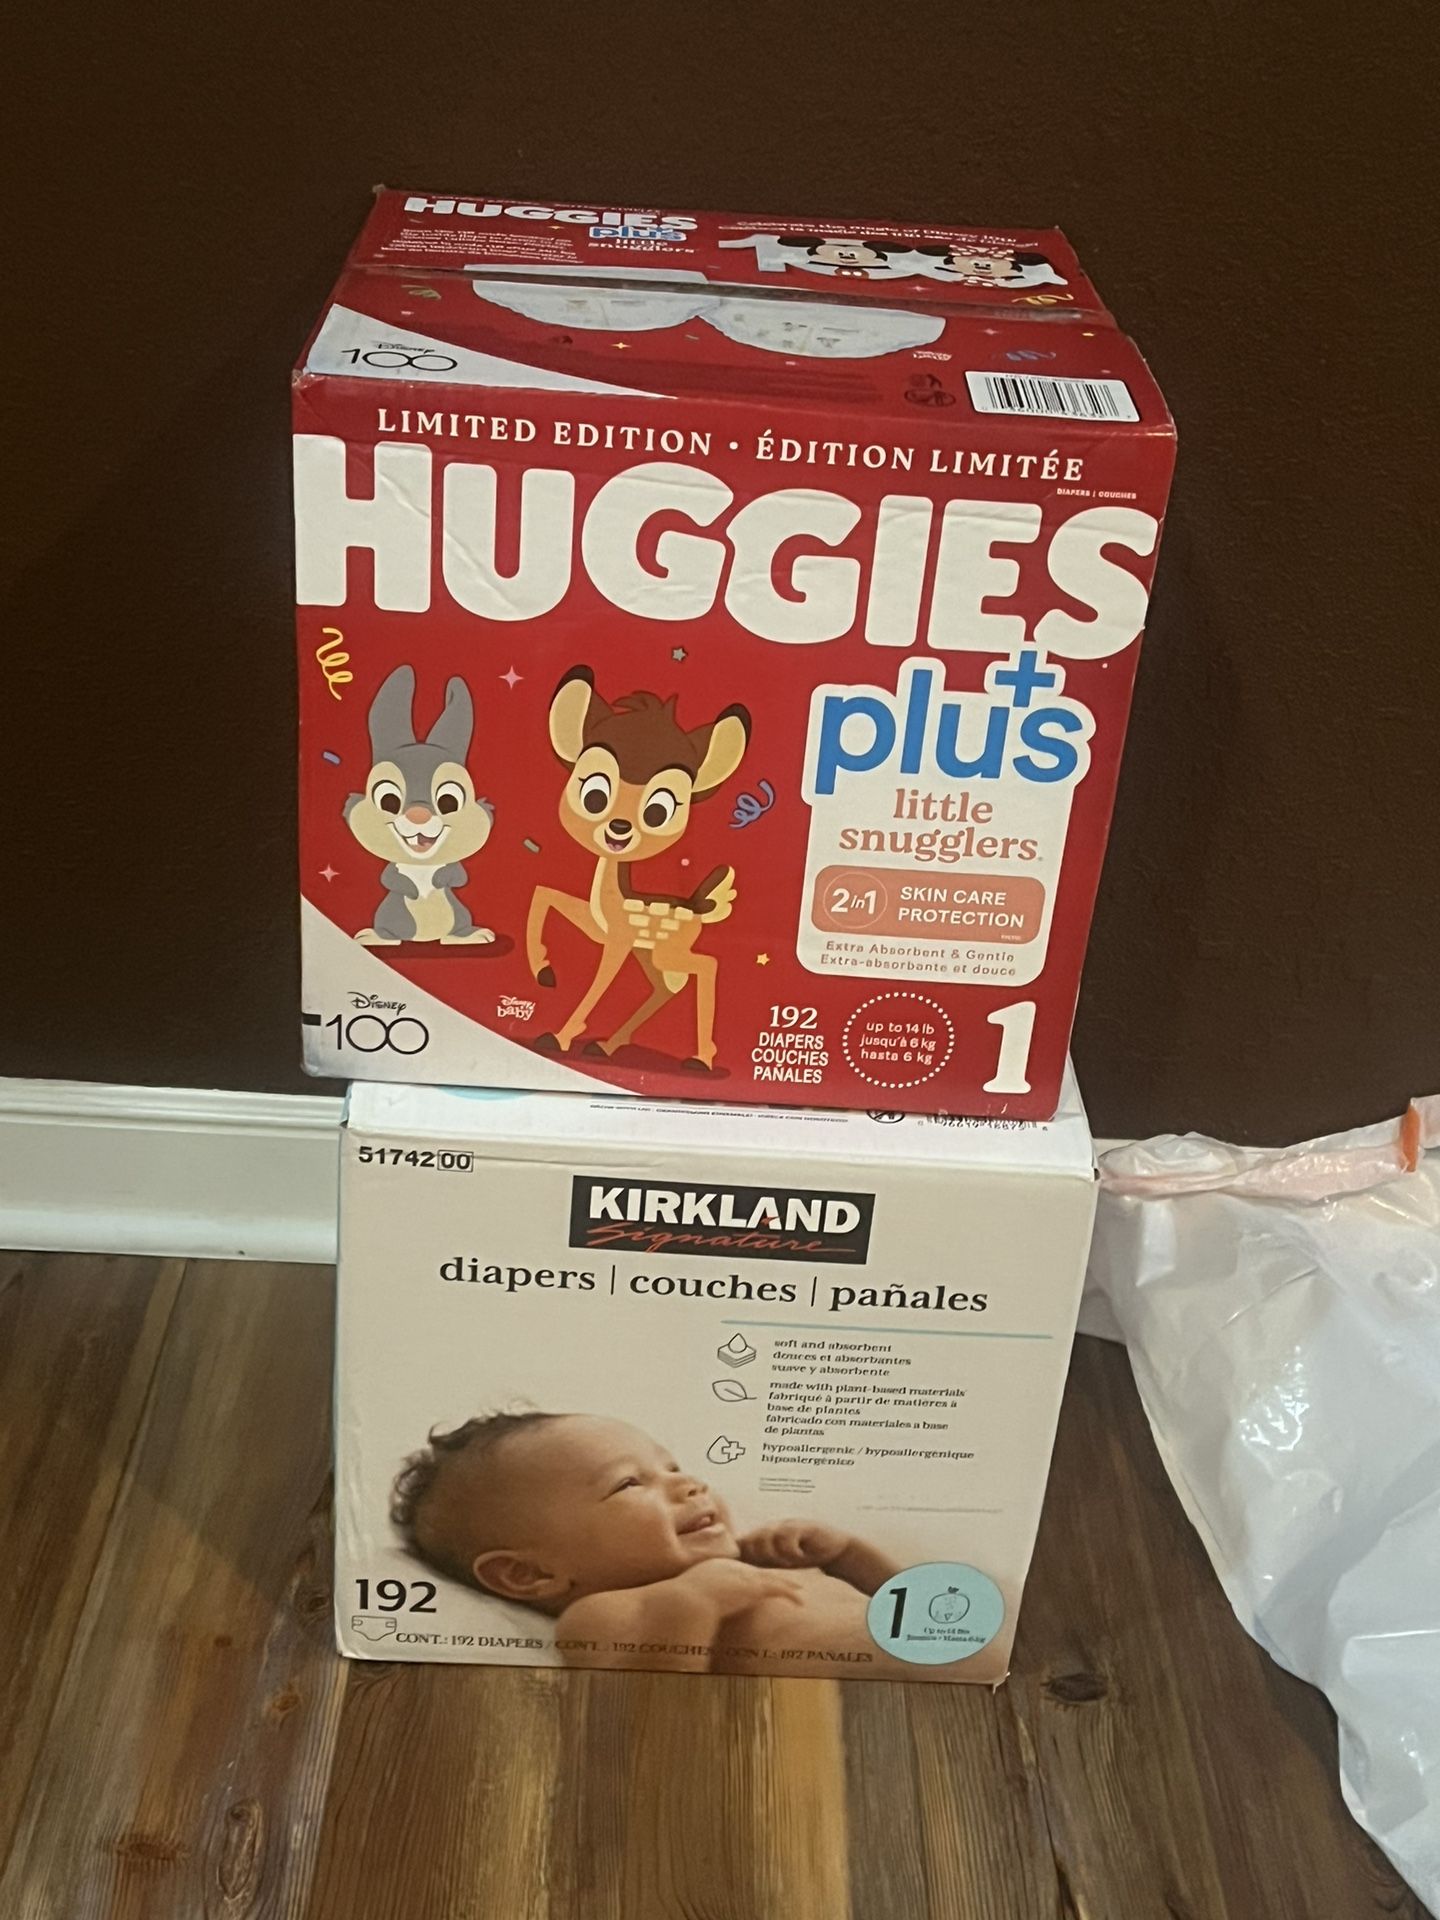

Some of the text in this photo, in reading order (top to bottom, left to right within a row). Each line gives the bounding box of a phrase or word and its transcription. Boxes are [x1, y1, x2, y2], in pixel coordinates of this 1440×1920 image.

[404, 197, 698, 230] HUGGIES
[590, 226, 686, 241] plus
[341, 348, 458, 371] 100
[377, 408, 1084, 481] LIMITED EDITION ÉDITION LIMITÉE
[293, 434, 1158, 660] HUGGIES
[814, 669, 1083, 794] plus
[893, 788, 993, 823] little
[839, 826, 1038, 863] snugglers
[900, 886, 1006, 906] SKIN CARE
[898, 908, 1025, 929] PROTECTION
[826, 940, 1015, 962] Extra Absorbent & Gentle
[820, 954, 1016, 977] Extra-absorbante et douce
[347, 991, 407, 1016] Disney
[496, 1005, 534, 1021] baby
[769, 1005, 818, 1029] 192
[325, 1014, 430, 1056] 100
[866, 1022, 935, 1035] up to 14 lb
[758, 1032, 824, 1050] DIAPERS
[909, 1037, 919, 1048] 6
[920, 1038, 936, 1051] kg
[982, 1001, 1037, 1094] 1
[751, 1048, 828, 1067] COUCHES
[860, 1049, 932, 1065] hasta 6 kg
[753, 1057, 822, 1084] PAÑALES
[590, 1186, 860, 1234] KIRKLAND
[586, 1221, 856, 1254] Signature
[440, 1257, 988, 1312] diapers couches pañales
[774, 1339, 891, 1352] soft and absorbent
[773, 1351, 817, 1361] douces
[834, 1355, 911, 1365] absorbantes
[772, 1364, 807, 1373] suave
[810, 1366, 817, 1375] y
[769, 1391, 823, 1403] fabriqué
[835, 1396, 872, 1405] partir
[875, 1397, 890, 1405] de
[770, 1381, 965, 1397] made with plant-based materials
[767, 1402, 861, 1415] base de plantes
[764, 1426, 824, 1436] de plantas
[766, 1414, 823, 1425] fabricado
[825, 1418, 846, 1426] con
[355, 1578, 437, 1613] 192
[889, 1587, 907, 1639] 1
[451, 1635, 474, 1647] 192
[478, 1637, 543, 1649] DIAPERS
